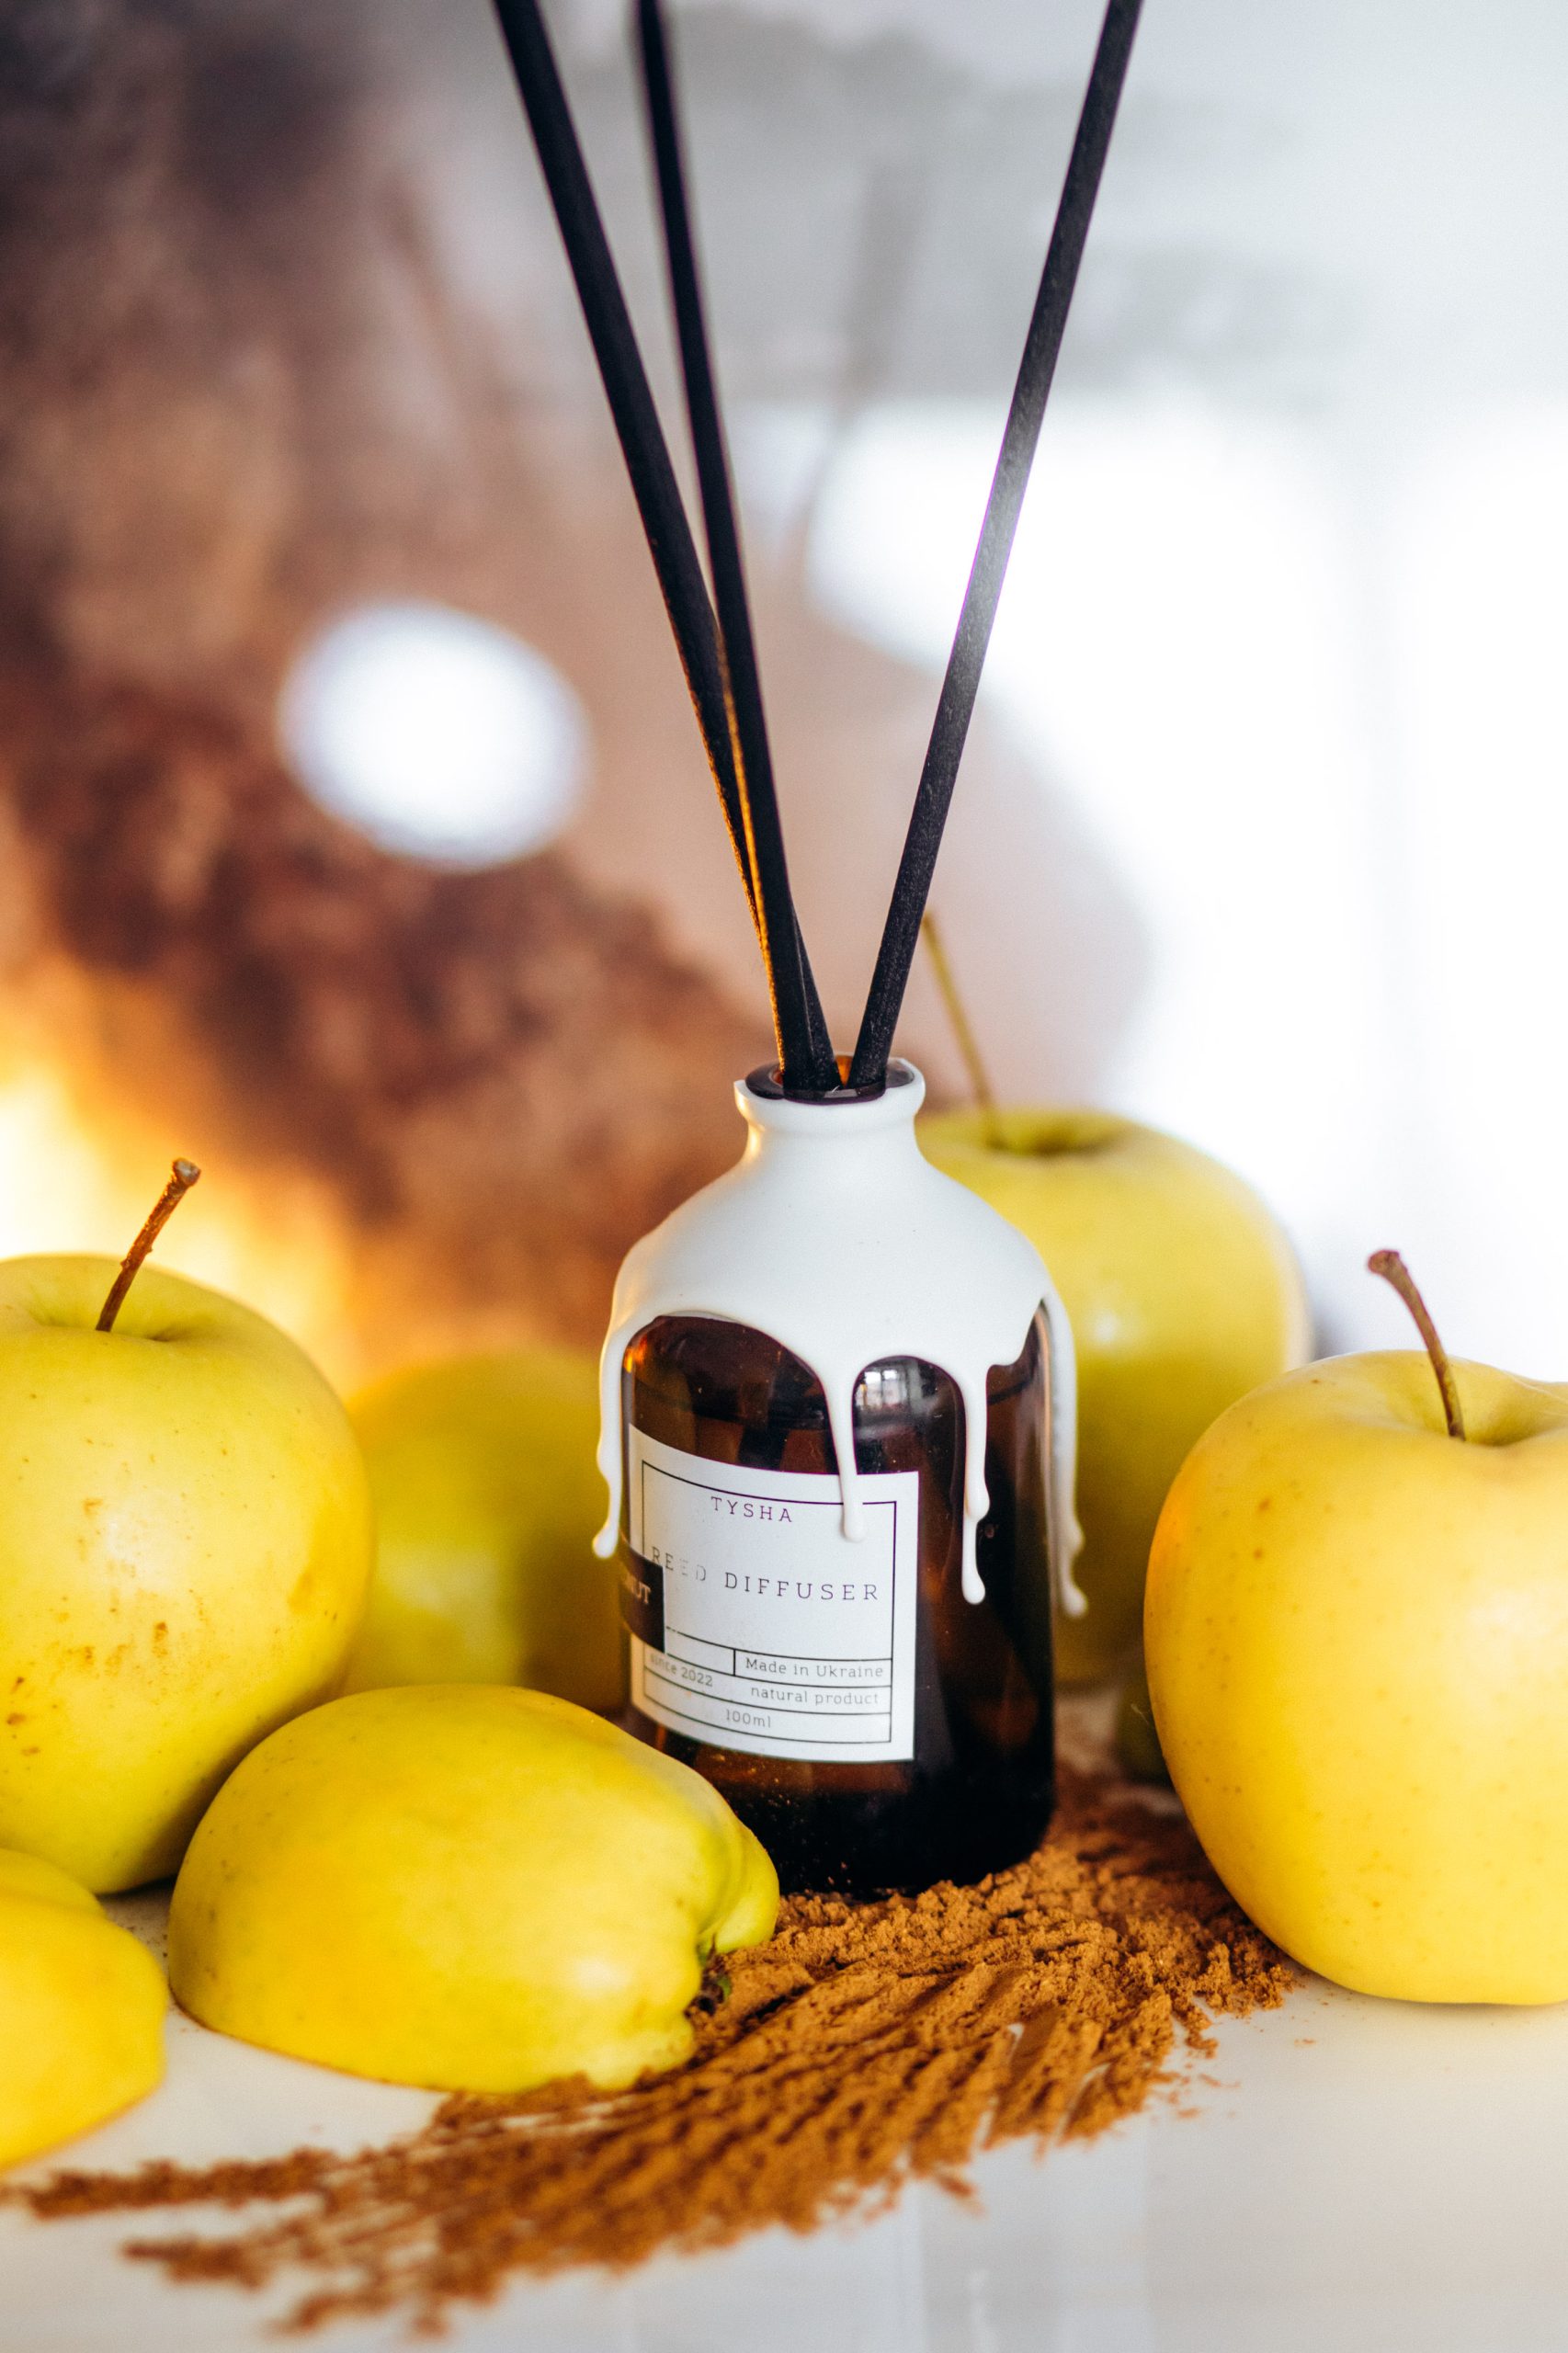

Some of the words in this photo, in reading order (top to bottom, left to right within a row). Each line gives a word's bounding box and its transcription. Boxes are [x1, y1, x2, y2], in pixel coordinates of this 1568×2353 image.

[710, 1495, 792, 1523] TYSHA
[724, 1572, 879, 1601] DIFFUSER
[649, 1654, 677, 1676] since
[681, 1665, 713, 1688] 2022
[745, 1657, 787, 1676] Made
[793, 1664, 810, 1677] in
[816, 1665, 883, 1678] Ukraine
[750, 1684, 809, 1704] natural
[814, 1692, 880, 1706] product
[726, 1709, 772, 1729] 100ml
